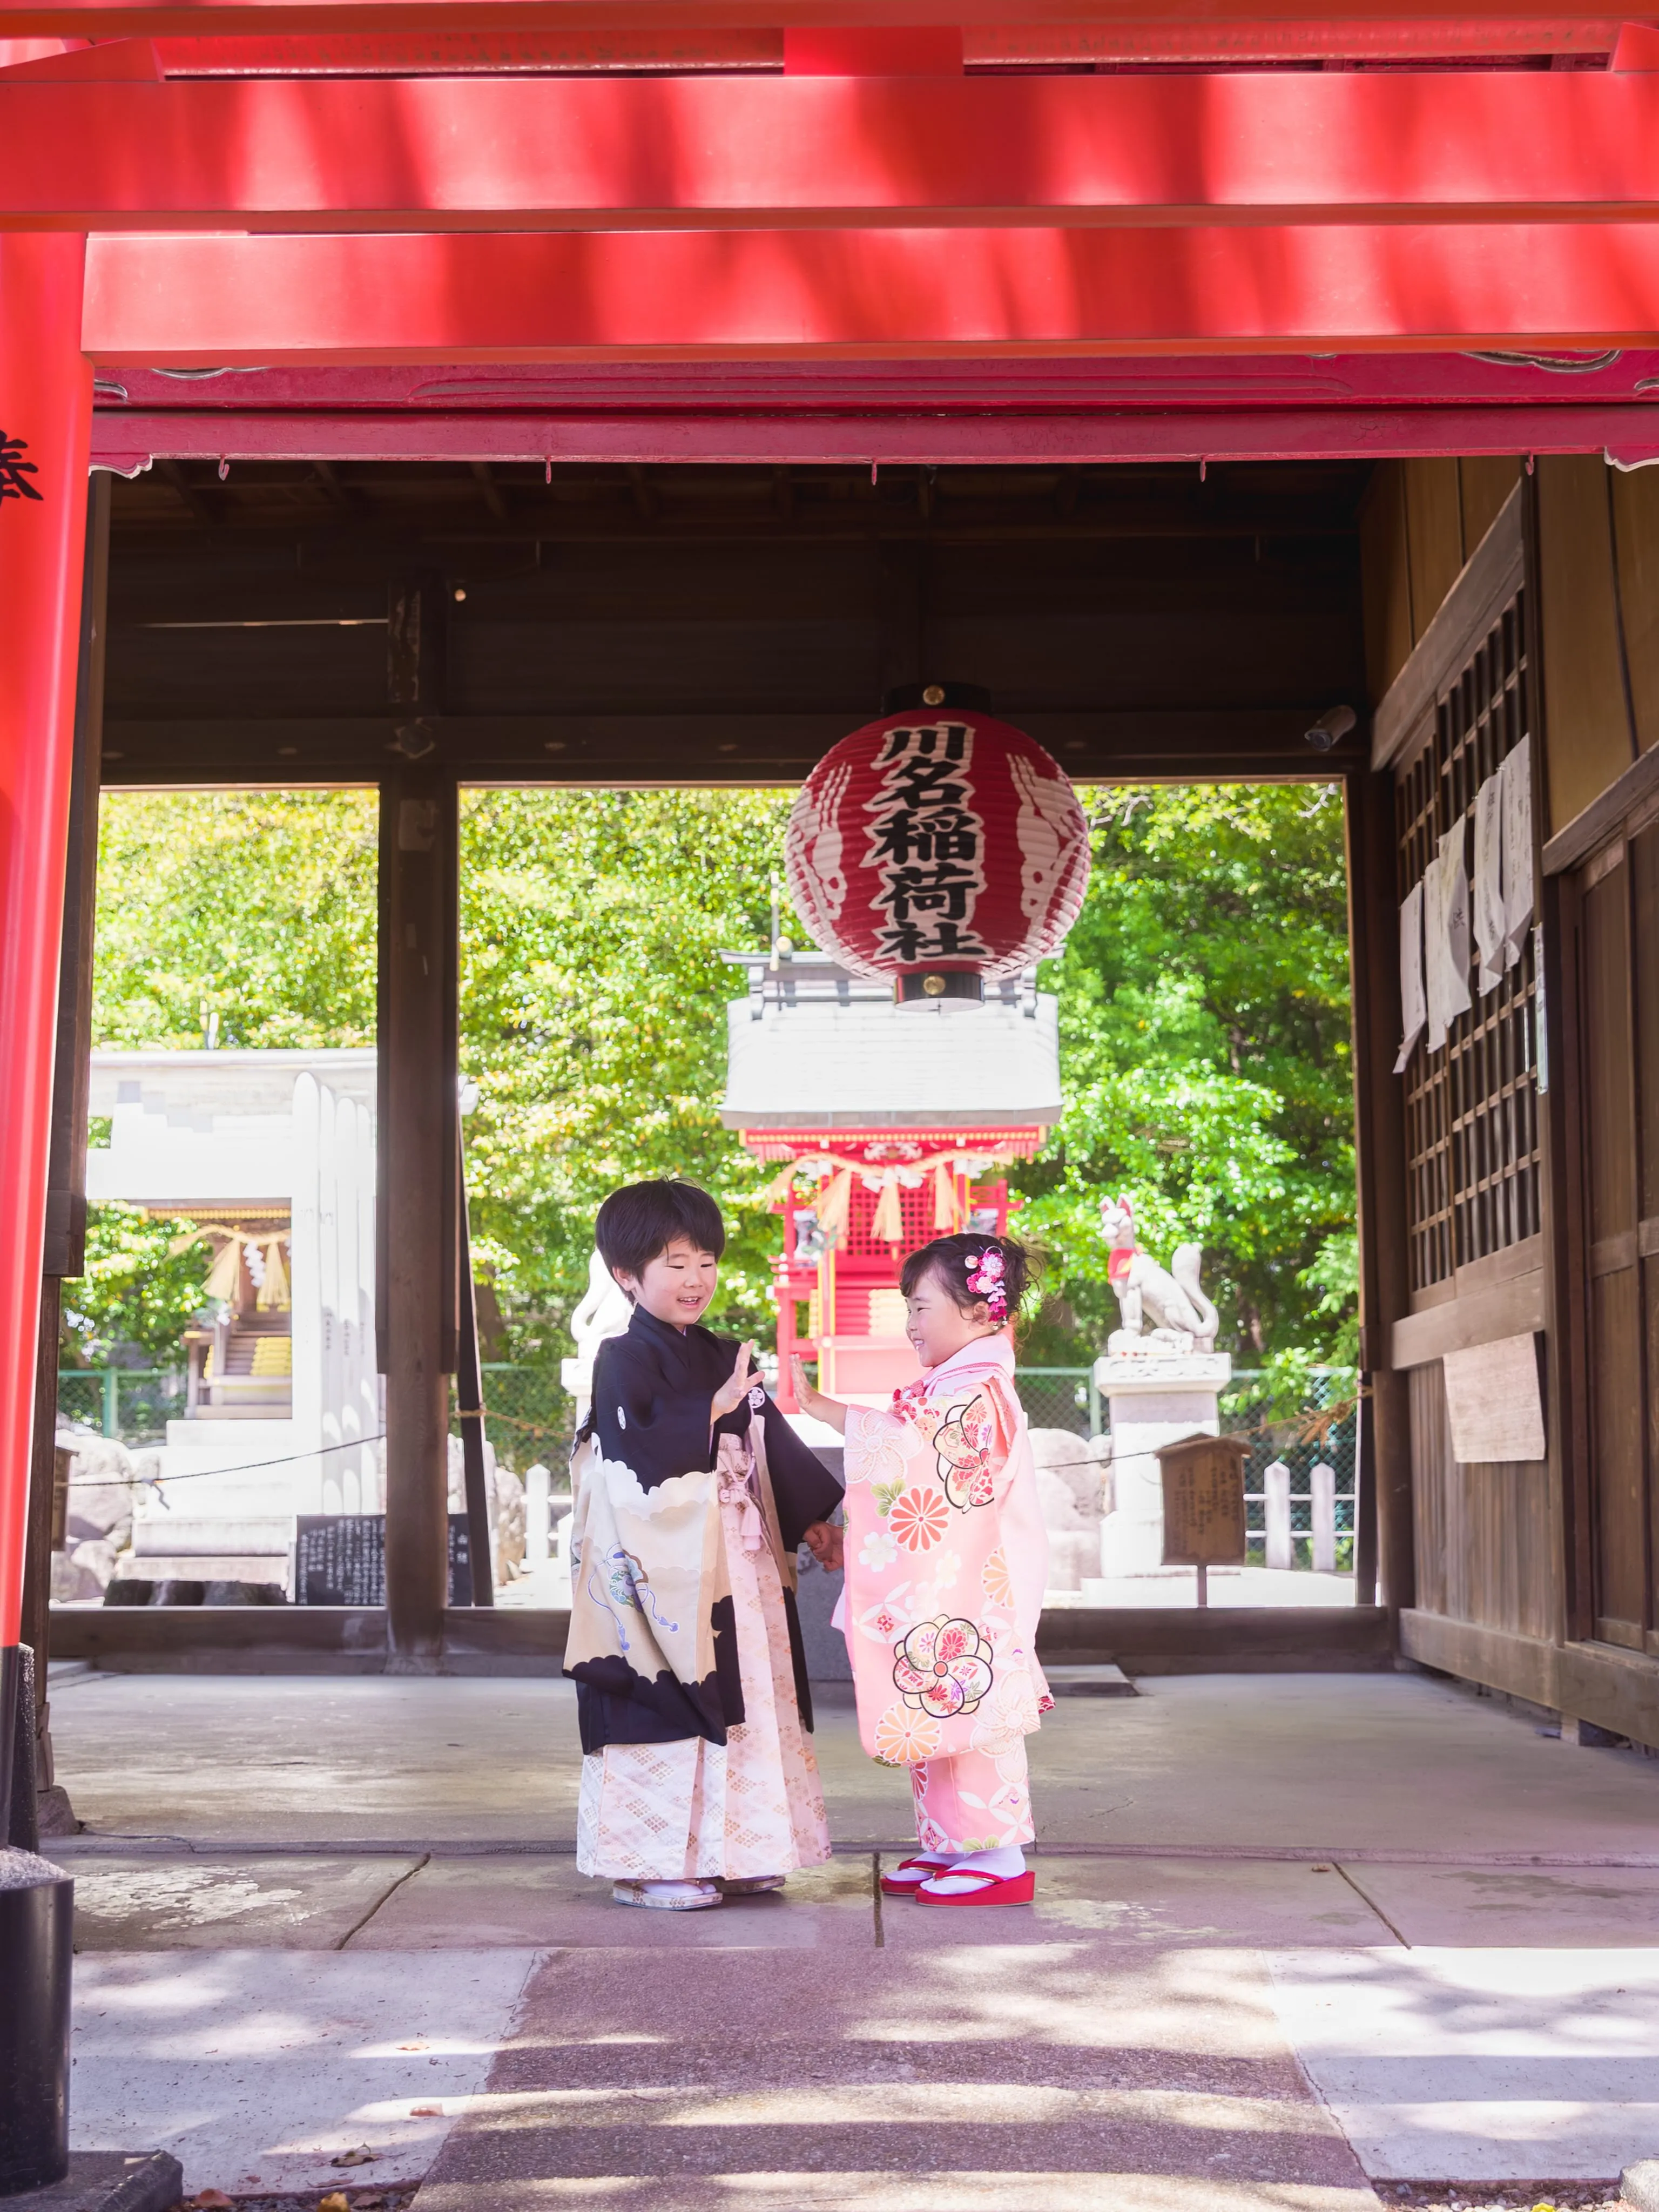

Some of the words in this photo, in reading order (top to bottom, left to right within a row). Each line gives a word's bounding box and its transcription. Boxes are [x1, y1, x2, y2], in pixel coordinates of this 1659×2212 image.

[871, 725, 988, 961] 川名稲荷社
